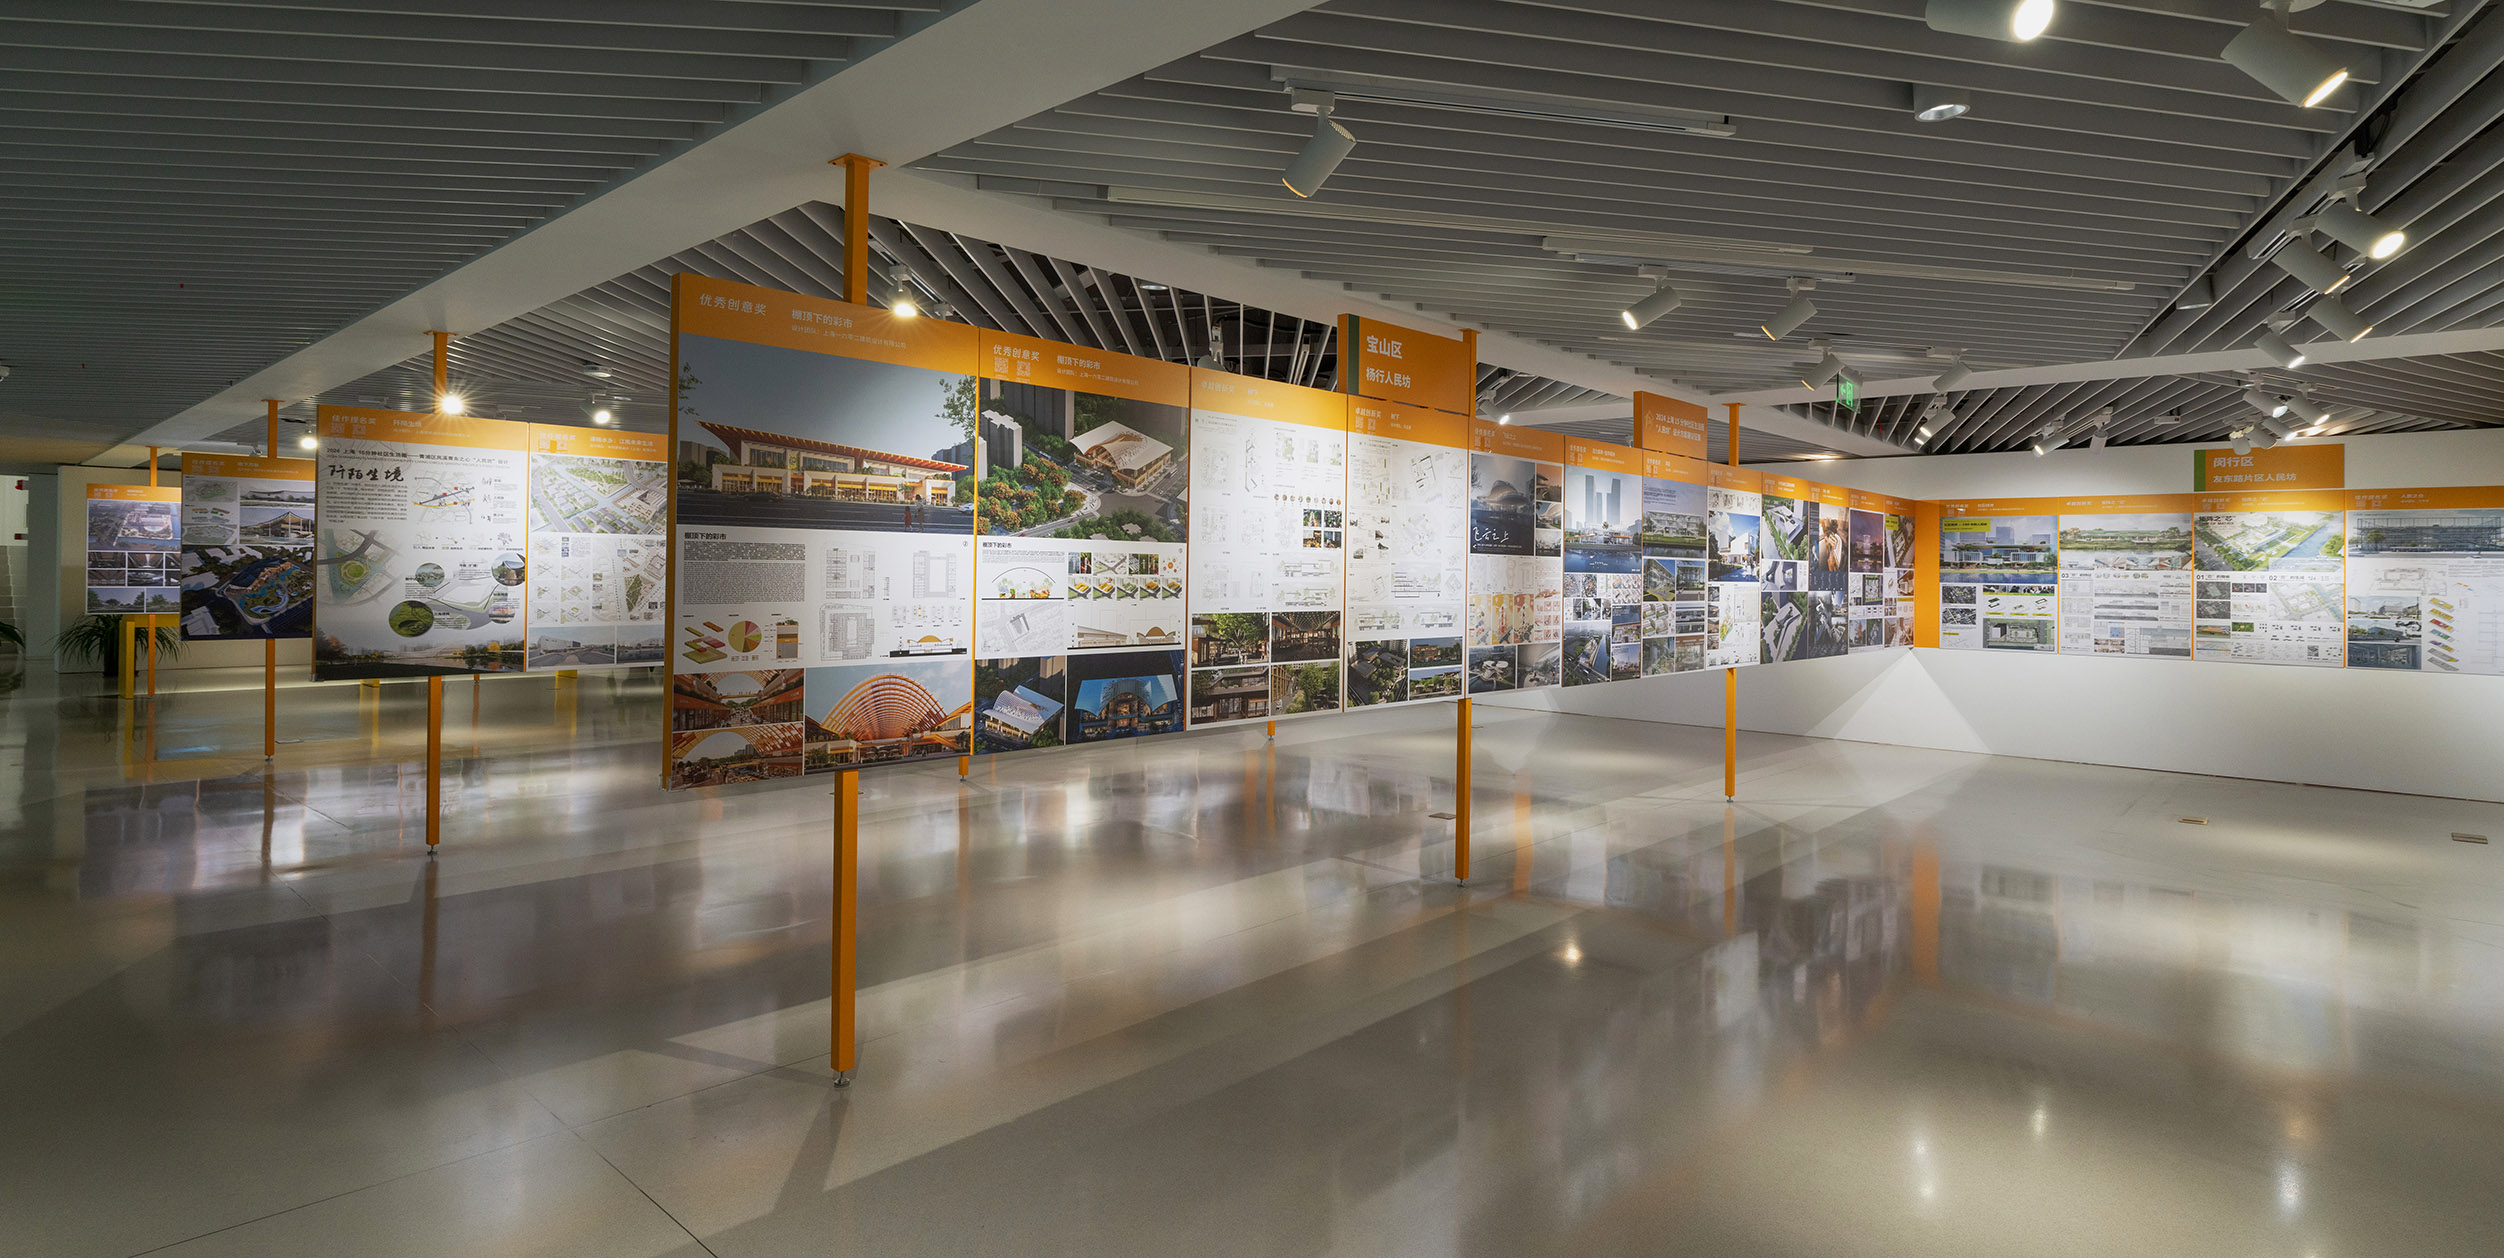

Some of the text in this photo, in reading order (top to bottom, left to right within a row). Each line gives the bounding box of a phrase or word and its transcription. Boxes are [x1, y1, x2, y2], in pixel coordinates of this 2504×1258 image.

[699, 293, 767, 317] 优秀创意奖
[992, 343, 1040, 362] 优秀创意奖
[1366, 334, 1403, 360] 宝山区
[1366, 366, 1411, 389] 杨行人民坊
[2213, 456, 2255, 468] 闵行区
[328, 464, 405, 483] 阡陌生境
[2213, 472, 2297, 484] 友东路片区人民坊
